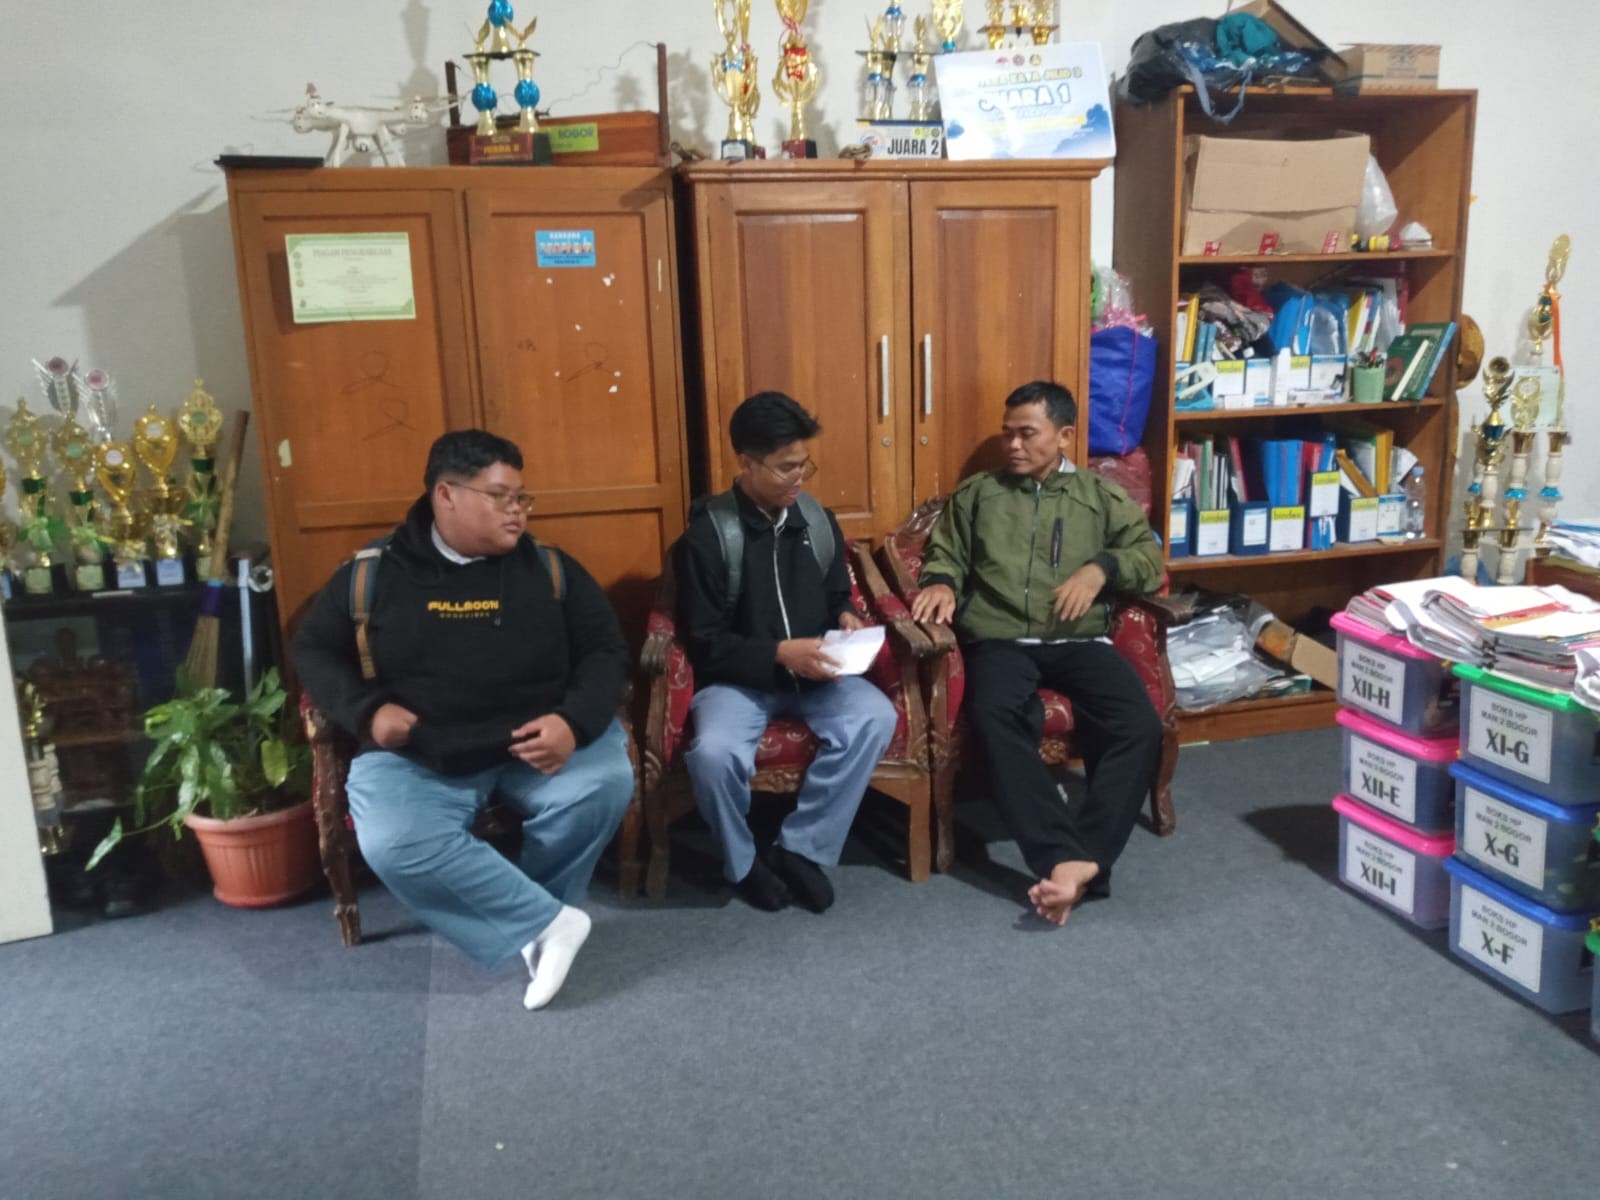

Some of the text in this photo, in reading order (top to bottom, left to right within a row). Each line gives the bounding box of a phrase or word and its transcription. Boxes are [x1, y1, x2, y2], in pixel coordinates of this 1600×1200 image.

[978, 82, 1071, 112] JARA 1
[887, 137, 939, 156] JUARA 2
[1351, 674, 1390, 709] XII-H
[1481, 710, 1498, 722] MAN
[1505, 719, 1538, 737] BOGOR
[1486, 728, 1529, 764] XI-G
[1361, 771, 1401, 808] XII-E
[1484, 832, 1519, 868] X-G
[1360, 861, 1396, 896] XII-I
[1481, 931, 1515, 965] X-F
